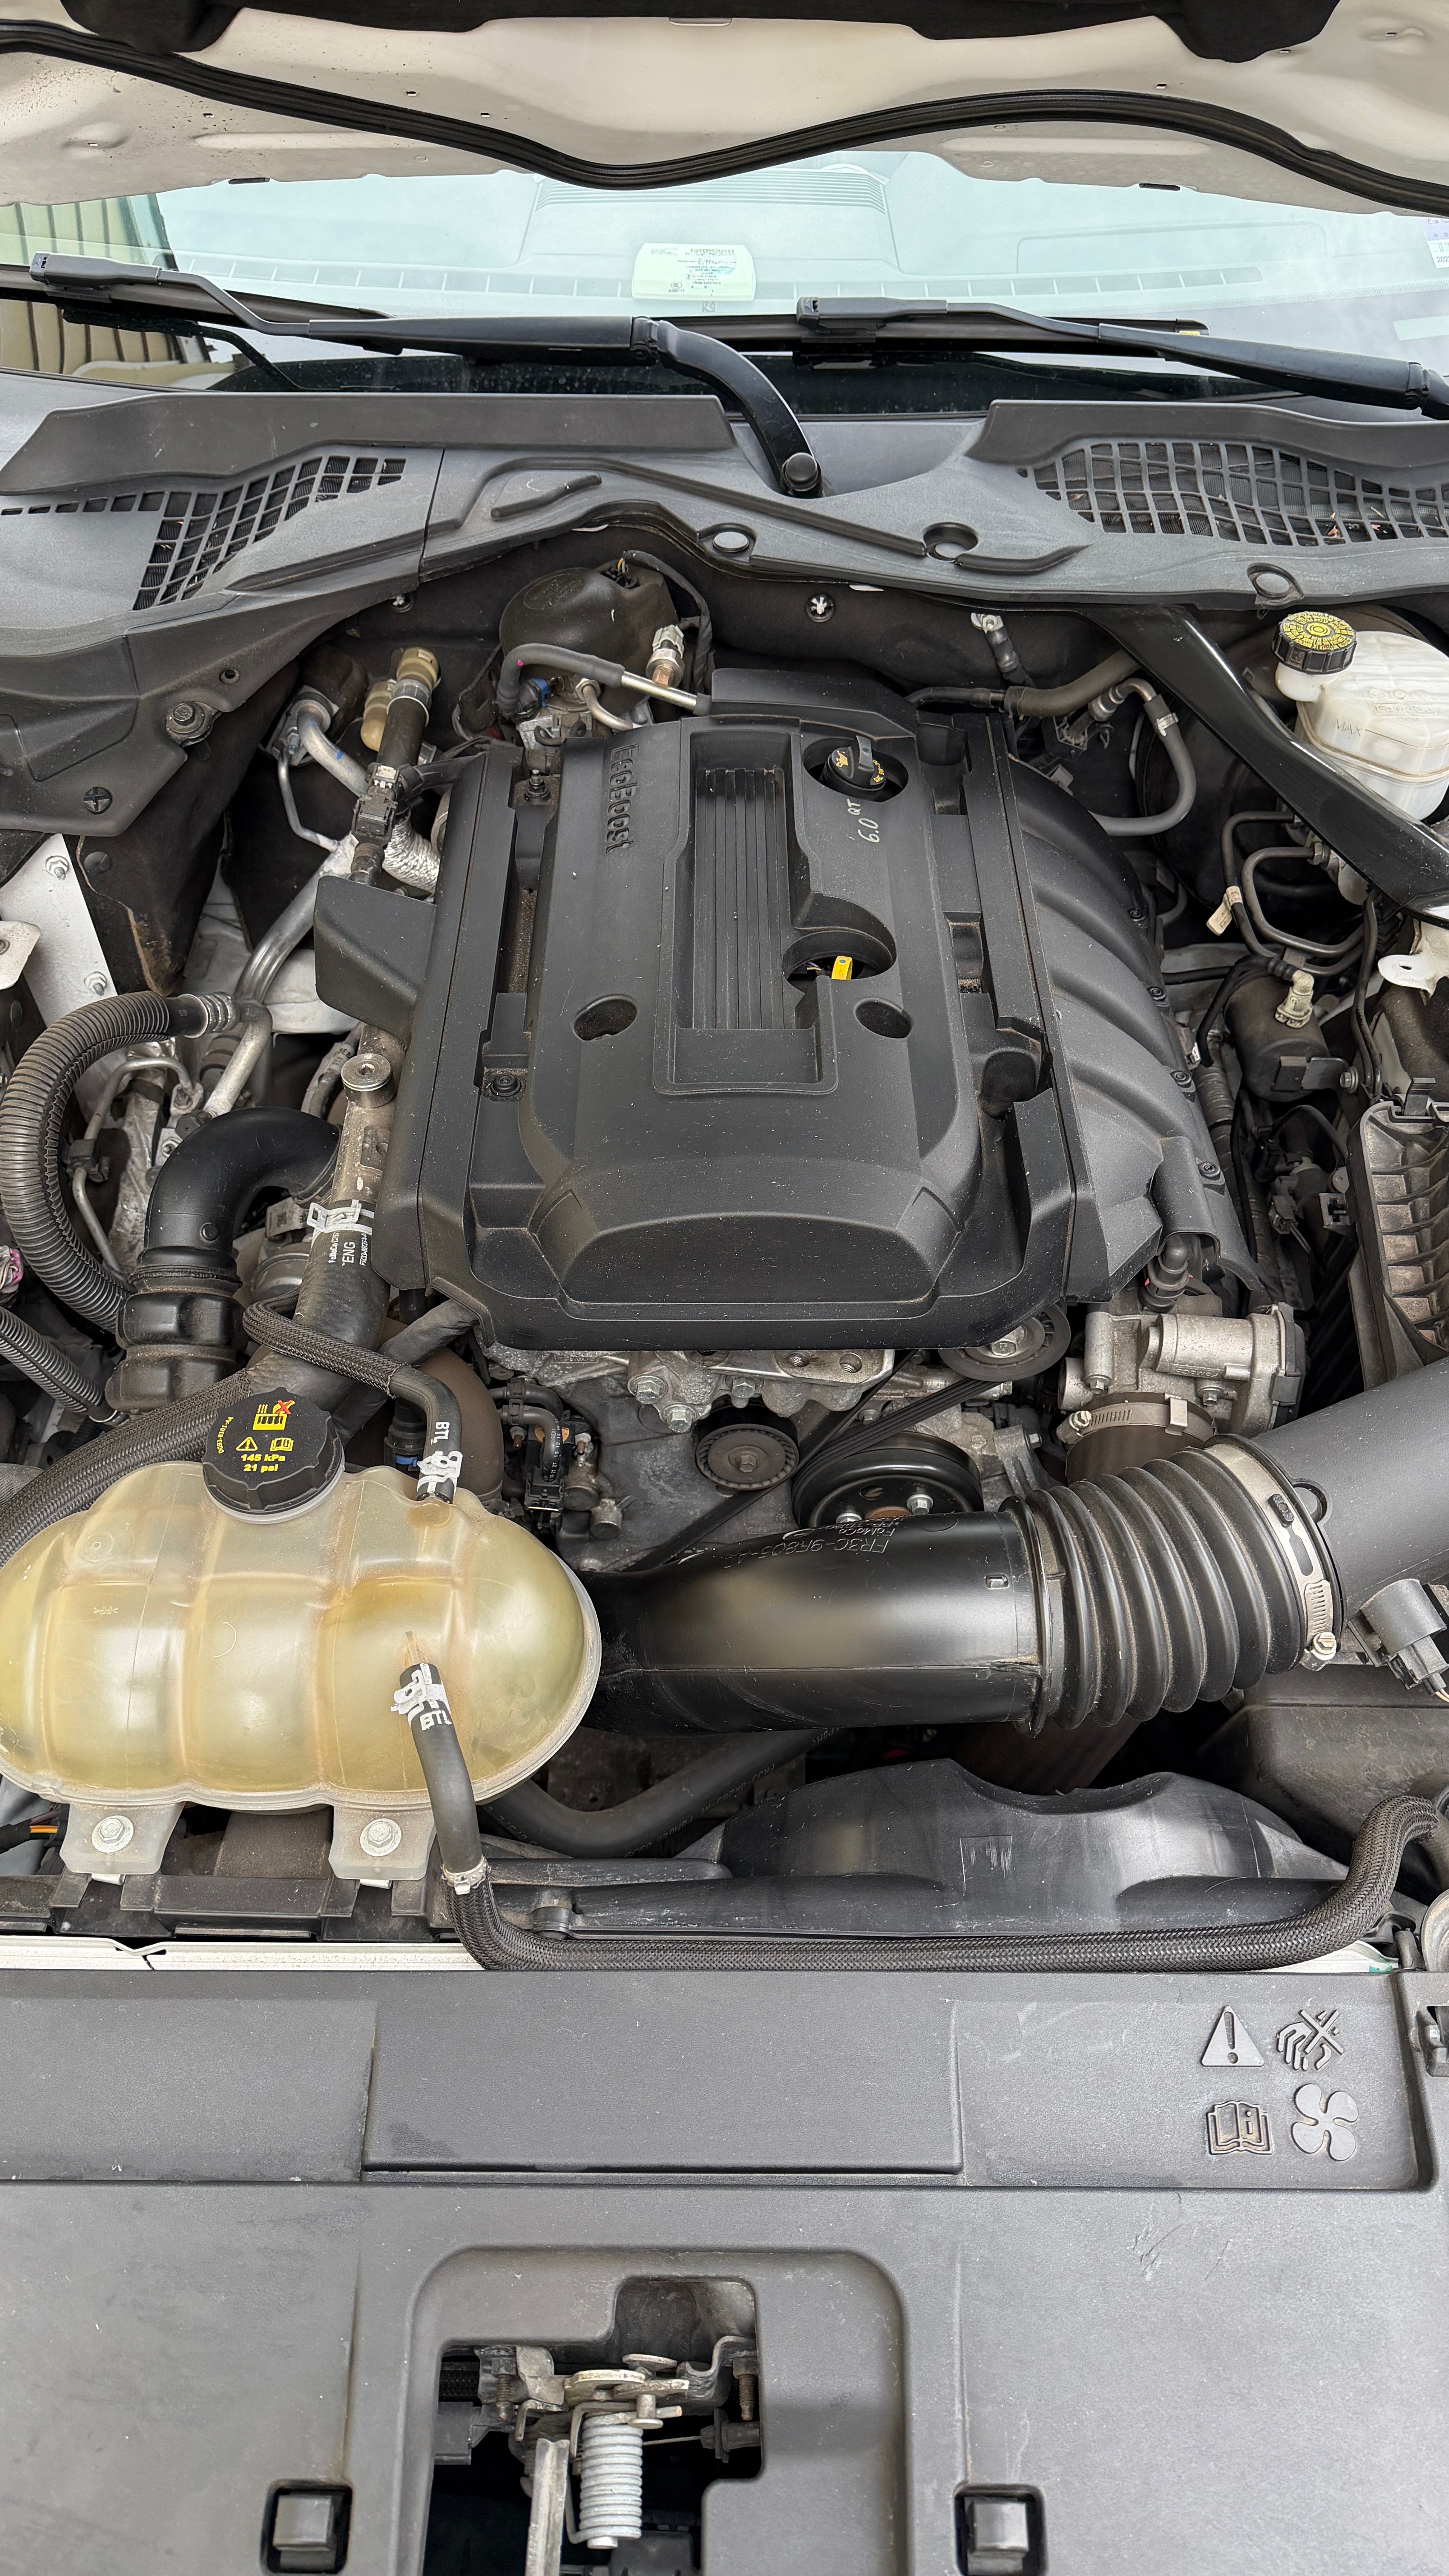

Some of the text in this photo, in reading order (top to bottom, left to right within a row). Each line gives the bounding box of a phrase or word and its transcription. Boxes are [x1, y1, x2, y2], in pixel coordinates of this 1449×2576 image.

[1336, 718, 1363, 737] MAX
[606, 743, 639, 854] EcoBoost
[846, 798, 861, 815] QT
[342, 1242, 355, 1263] ENG
[243, 1464, 279, 1473] 21 psi
[419, 1710, 452, 1731] BTL
